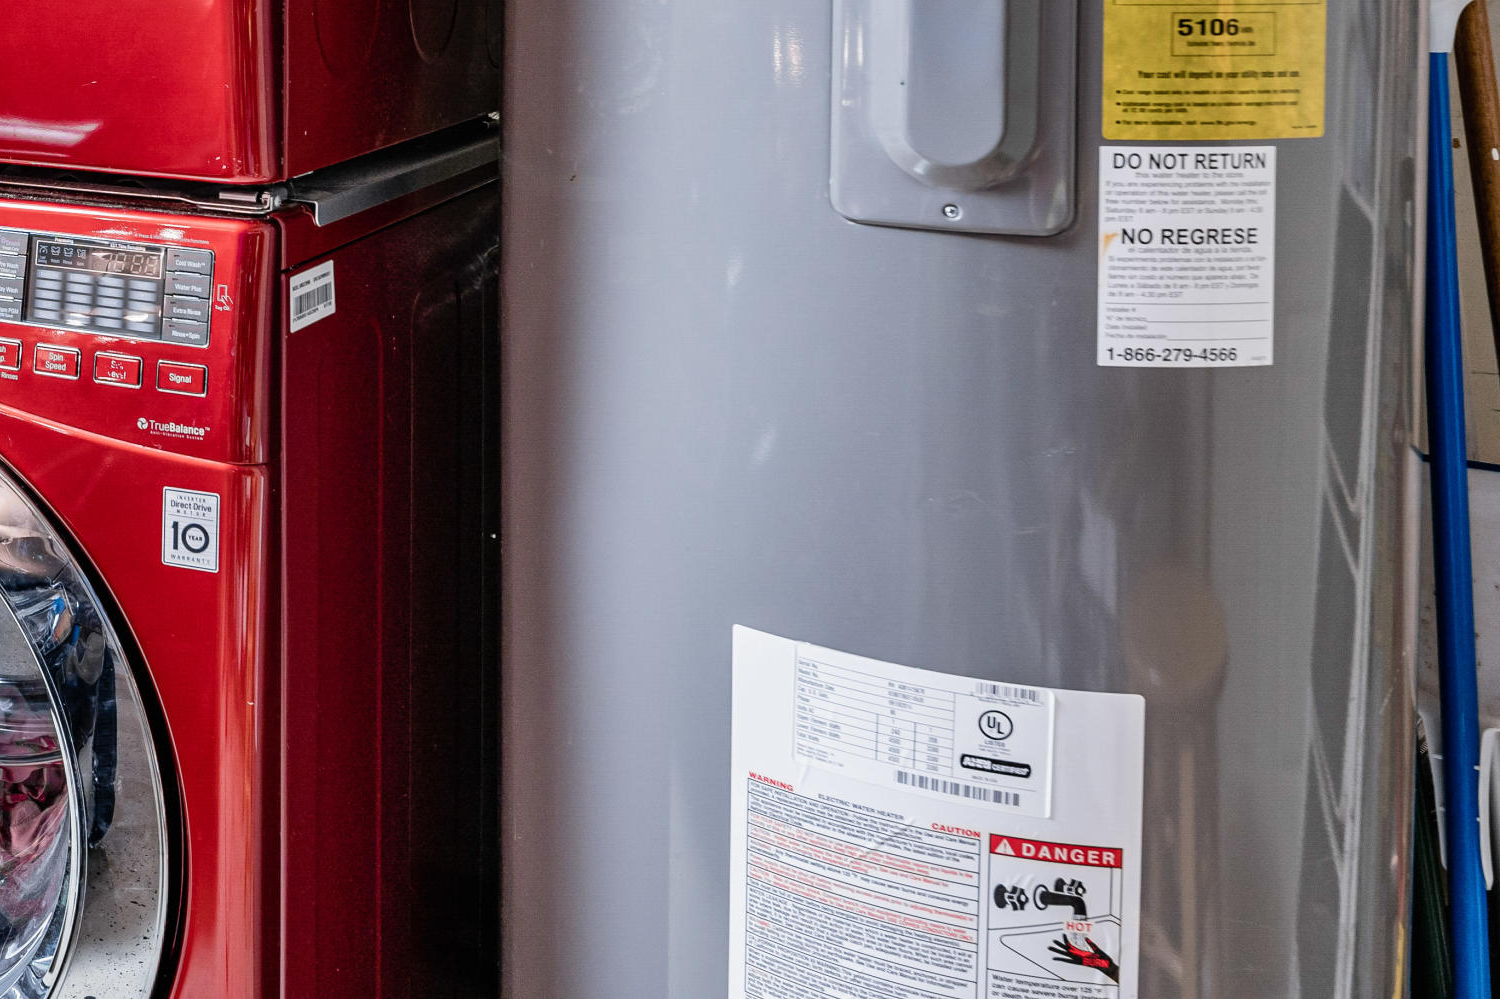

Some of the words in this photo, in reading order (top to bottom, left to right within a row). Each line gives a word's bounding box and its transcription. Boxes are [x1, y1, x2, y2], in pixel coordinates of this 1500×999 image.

[1178, 18, 1240, 37] 5106
[1138, 70, 1155, 79] Your
[1157, 71, 1171, 79] cost
[1174, 70, 1186, 79] will
[1188, 70, 1213, 80] depend
[1113, 153, 1142, 169] DO
[1150, 153, 1188, 169] NOT
[1194, 153, 1267, 169] RETURN
[1121, 228, 1153, 245] NO
[1161, 228, 1259, 245] REGRESE
[174, 282, 190, 291] Water
[172, 306, 187, 315] Extra
[48, 352, 64, 363] Spin
[1106, 347, 1238, 362] 1-866-279-4566
[45, 362, 67, 372] Speed
[1, 372, 19, 381] Rinses
[168, 372, 192, 384] Signal
[176, 495, 206, 503] INVERTER
[170, 499, 192, 510] Direct
[193, 502, 212, 513] Drive
[176, 509, 206, 517] MOTOR
[171, 520, 210, 554] 10
[170, 553, 211, 565] WARRANTY
[987, 715, 1005, 735] UL
[749, 771, 795, 792] WARNING
[818, 793, 850, 807] ELECTRIC
[851, 802, 876, 815] WATER
[876, 809, 904, 821] HEATER
[931, 822, 981, 838] CAUTION
[1021, 843, 1116, 866] DANGER
[1066, 921, 1093, 933] HOT
[991, 973, 1013, 983] Water
[1015, 979, 1060, 990] temperature
[1007, 985, 1030, 993] cause
[1031, 990, 1056, 998] severe
